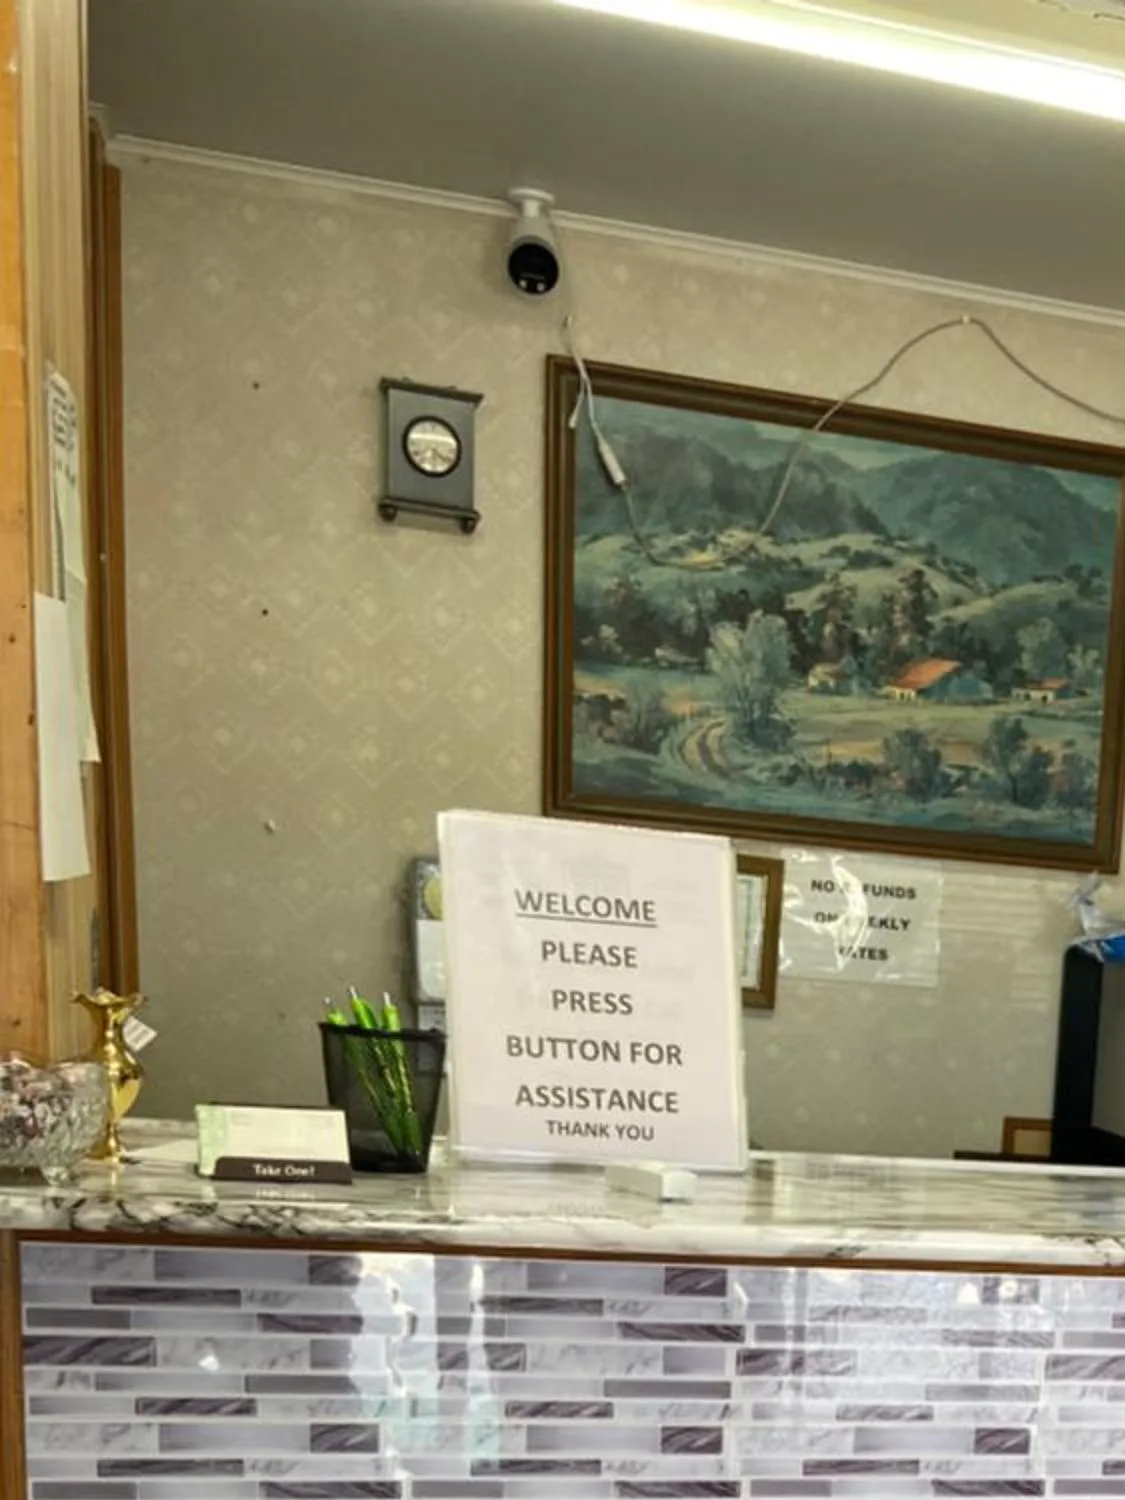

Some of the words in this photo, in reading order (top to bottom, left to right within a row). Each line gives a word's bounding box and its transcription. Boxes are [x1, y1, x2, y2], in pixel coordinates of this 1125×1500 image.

[810, 879, 835, 893] NO
[840, 881, 917, 900] FUNDS
[515, 889, 656, 922] WELCOME
[541, 940, 637, 969] PLEASE
[552, 989, 634, 1015] PRESS
[507, 1035, 621, 1063] BUTTON
[630, 1042, 683, 1067] FOR
[515, 1084, 679, 1114] ASSISTANCE
[546, 1118, 610, 1139] THANK
[615, 1122, 655, 1142] YOU
[252, 1163, 281, 1177] Take
